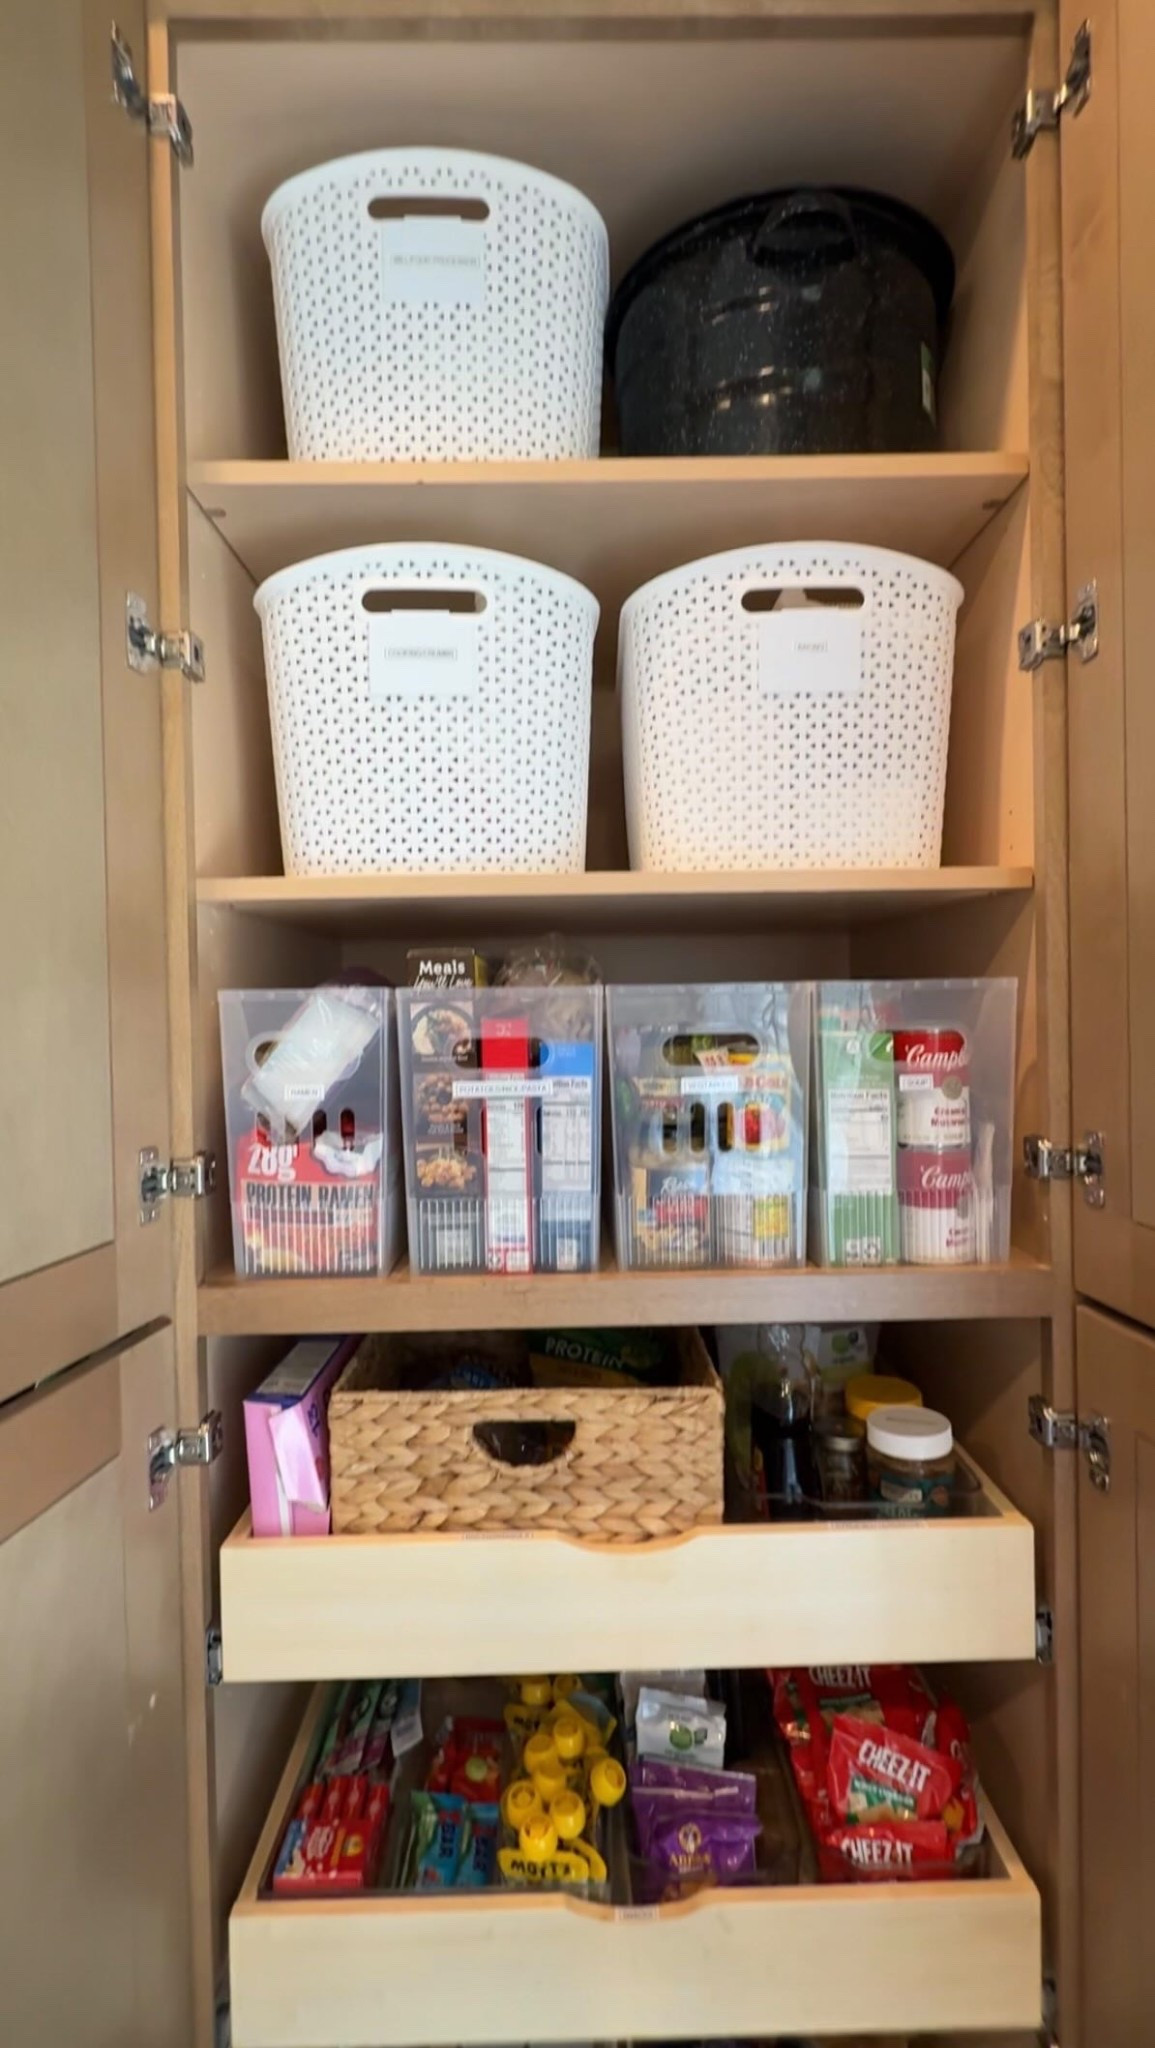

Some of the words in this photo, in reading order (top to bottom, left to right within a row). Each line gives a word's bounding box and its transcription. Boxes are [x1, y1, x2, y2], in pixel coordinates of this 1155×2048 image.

[419, 959, 466, 976] Meals
[245, 1183, 312, 1208] PROTEIN
[318, 1184, 374, 1209] RAMEN
[545, 1336, 624, 1370] PROTEIN
